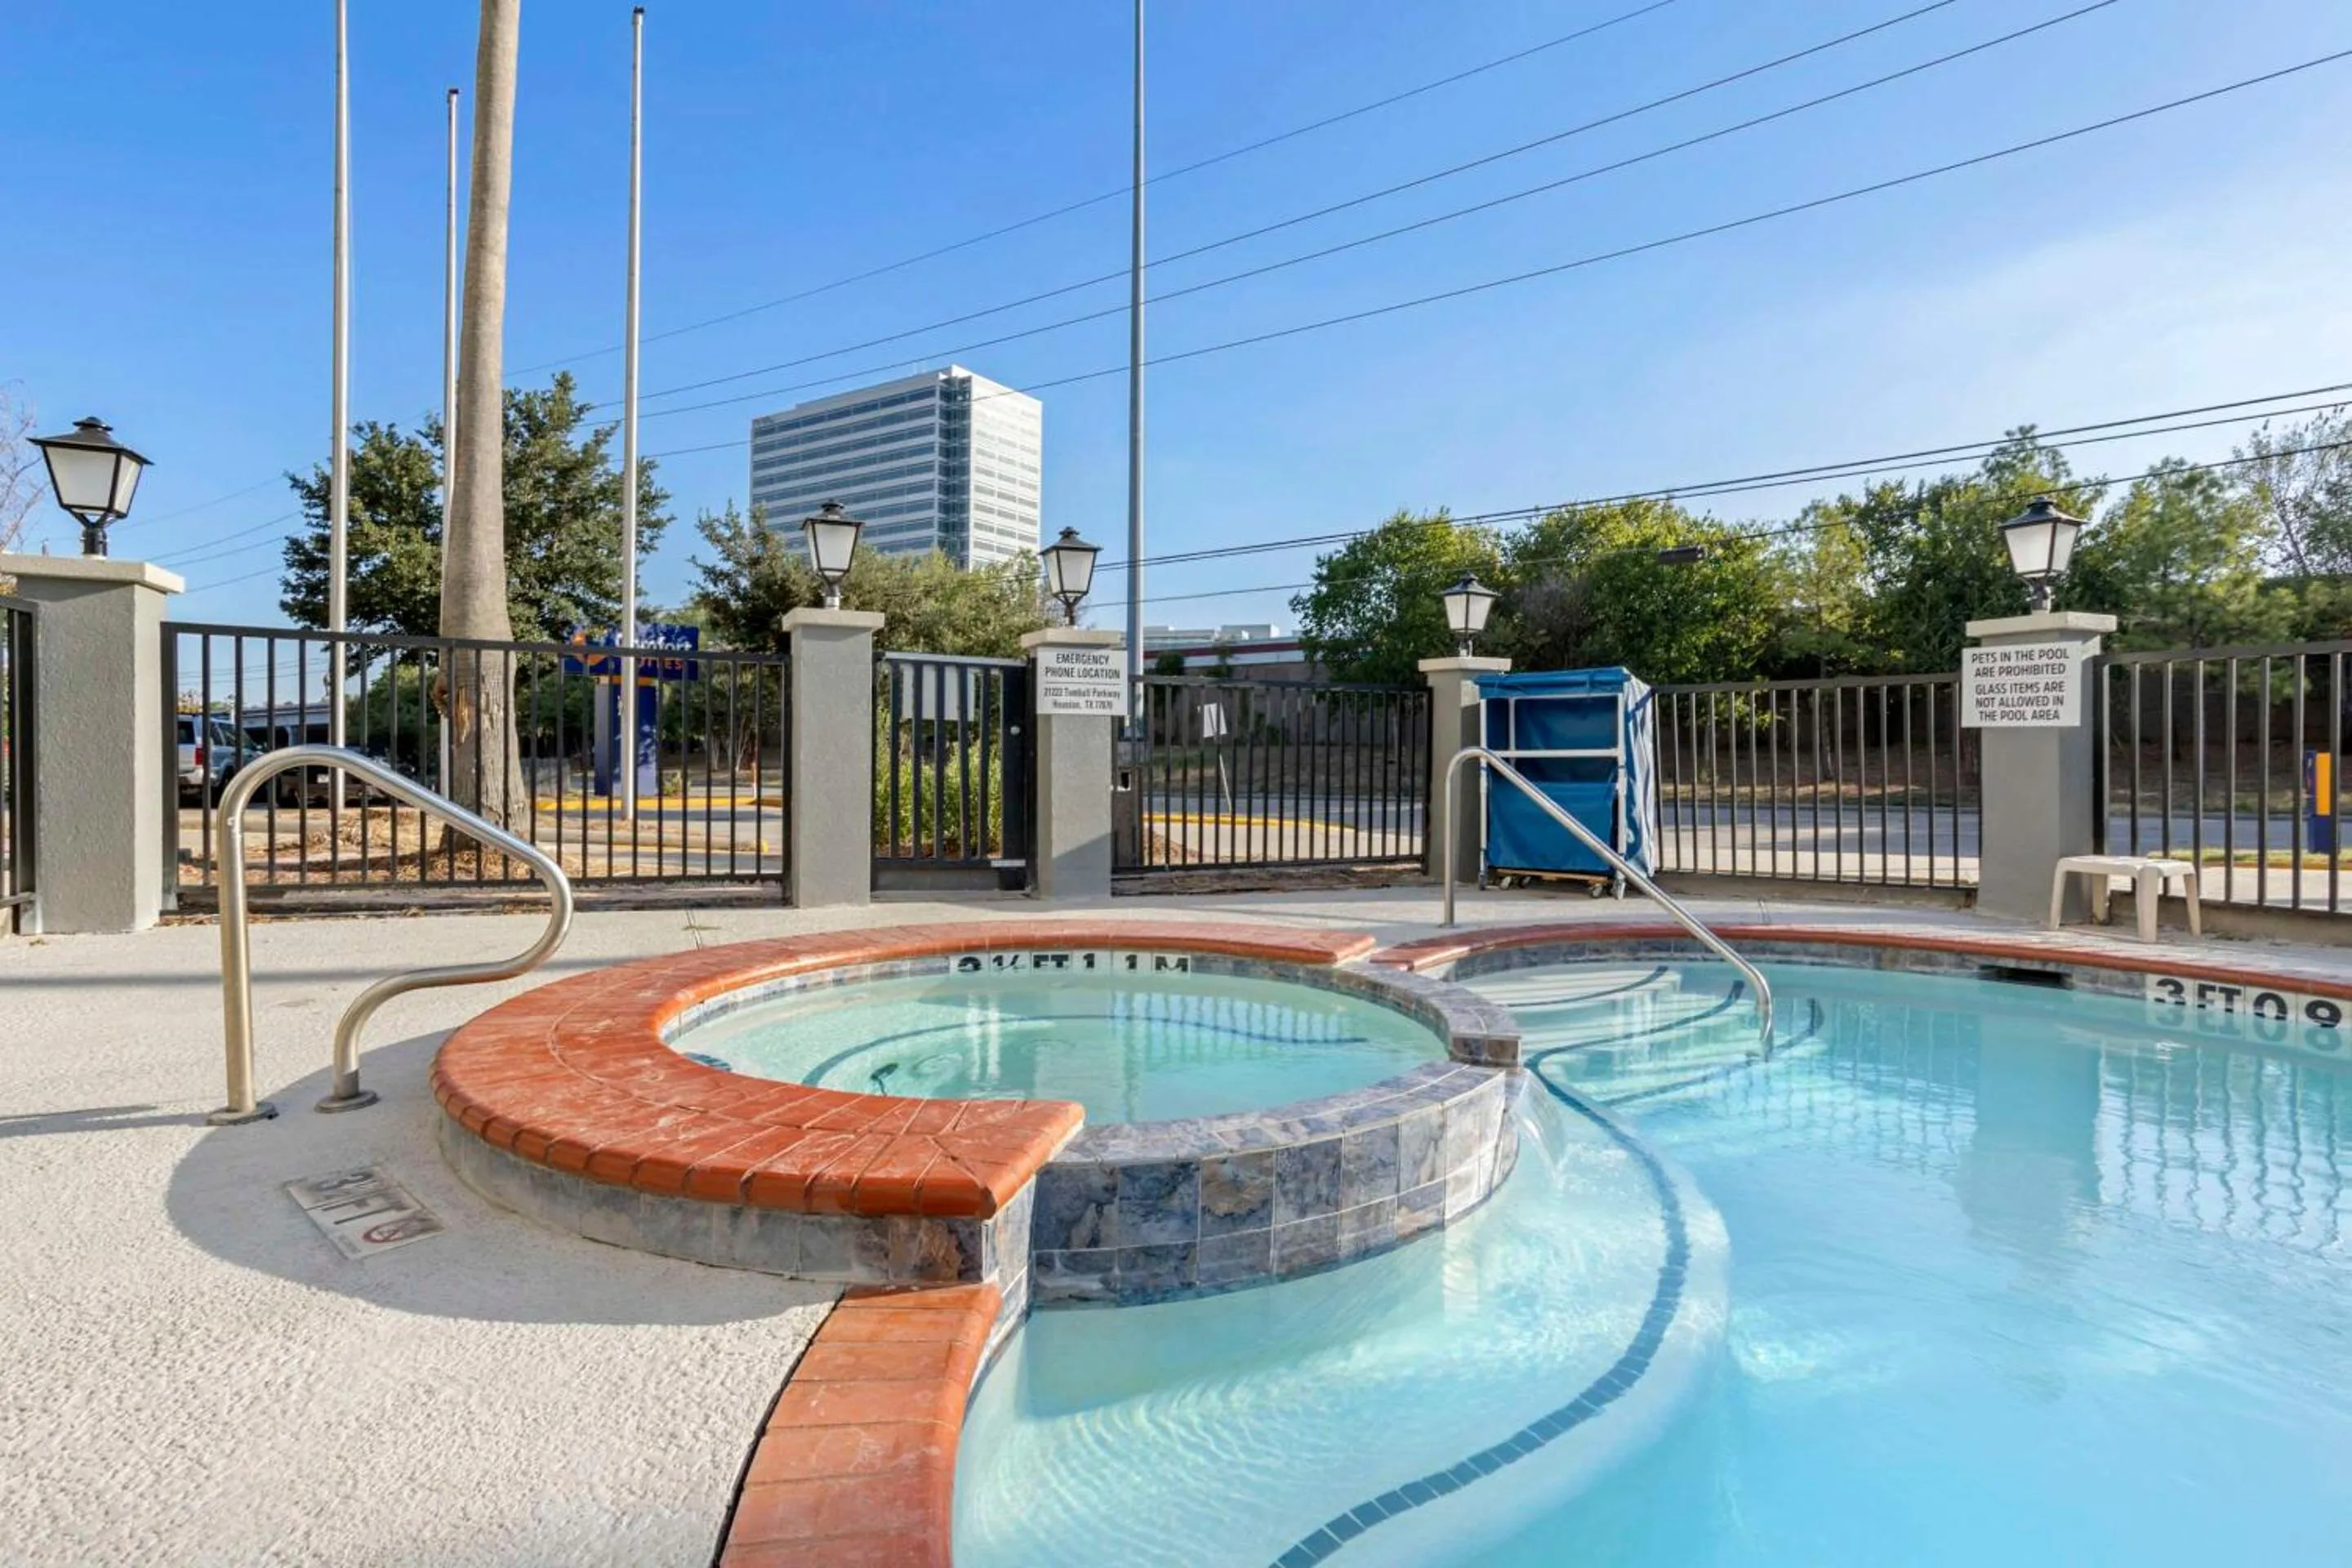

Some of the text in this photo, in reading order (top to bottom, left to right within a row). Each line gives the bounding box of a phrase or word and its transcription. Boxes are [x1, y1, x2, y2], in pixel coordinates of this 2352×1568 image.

[1056, 653, 1109, 665] EMERGENCY
[1971, 648, 2070, 663] PETS IN THE POOL
[1045, 666, 1120, 679] PHONE LOCATION
[1975, 663, 2066, 678] ARE PROHIBITED
[1093, 688, 1120, 699] Parkway
[1976, 680, 2065, 695] GLASS ITEMS ARE
[1976, 695, 2065, 708] NOT ALLOWED IN
[1980, 709, 2060, 721] THE POOL AREA
